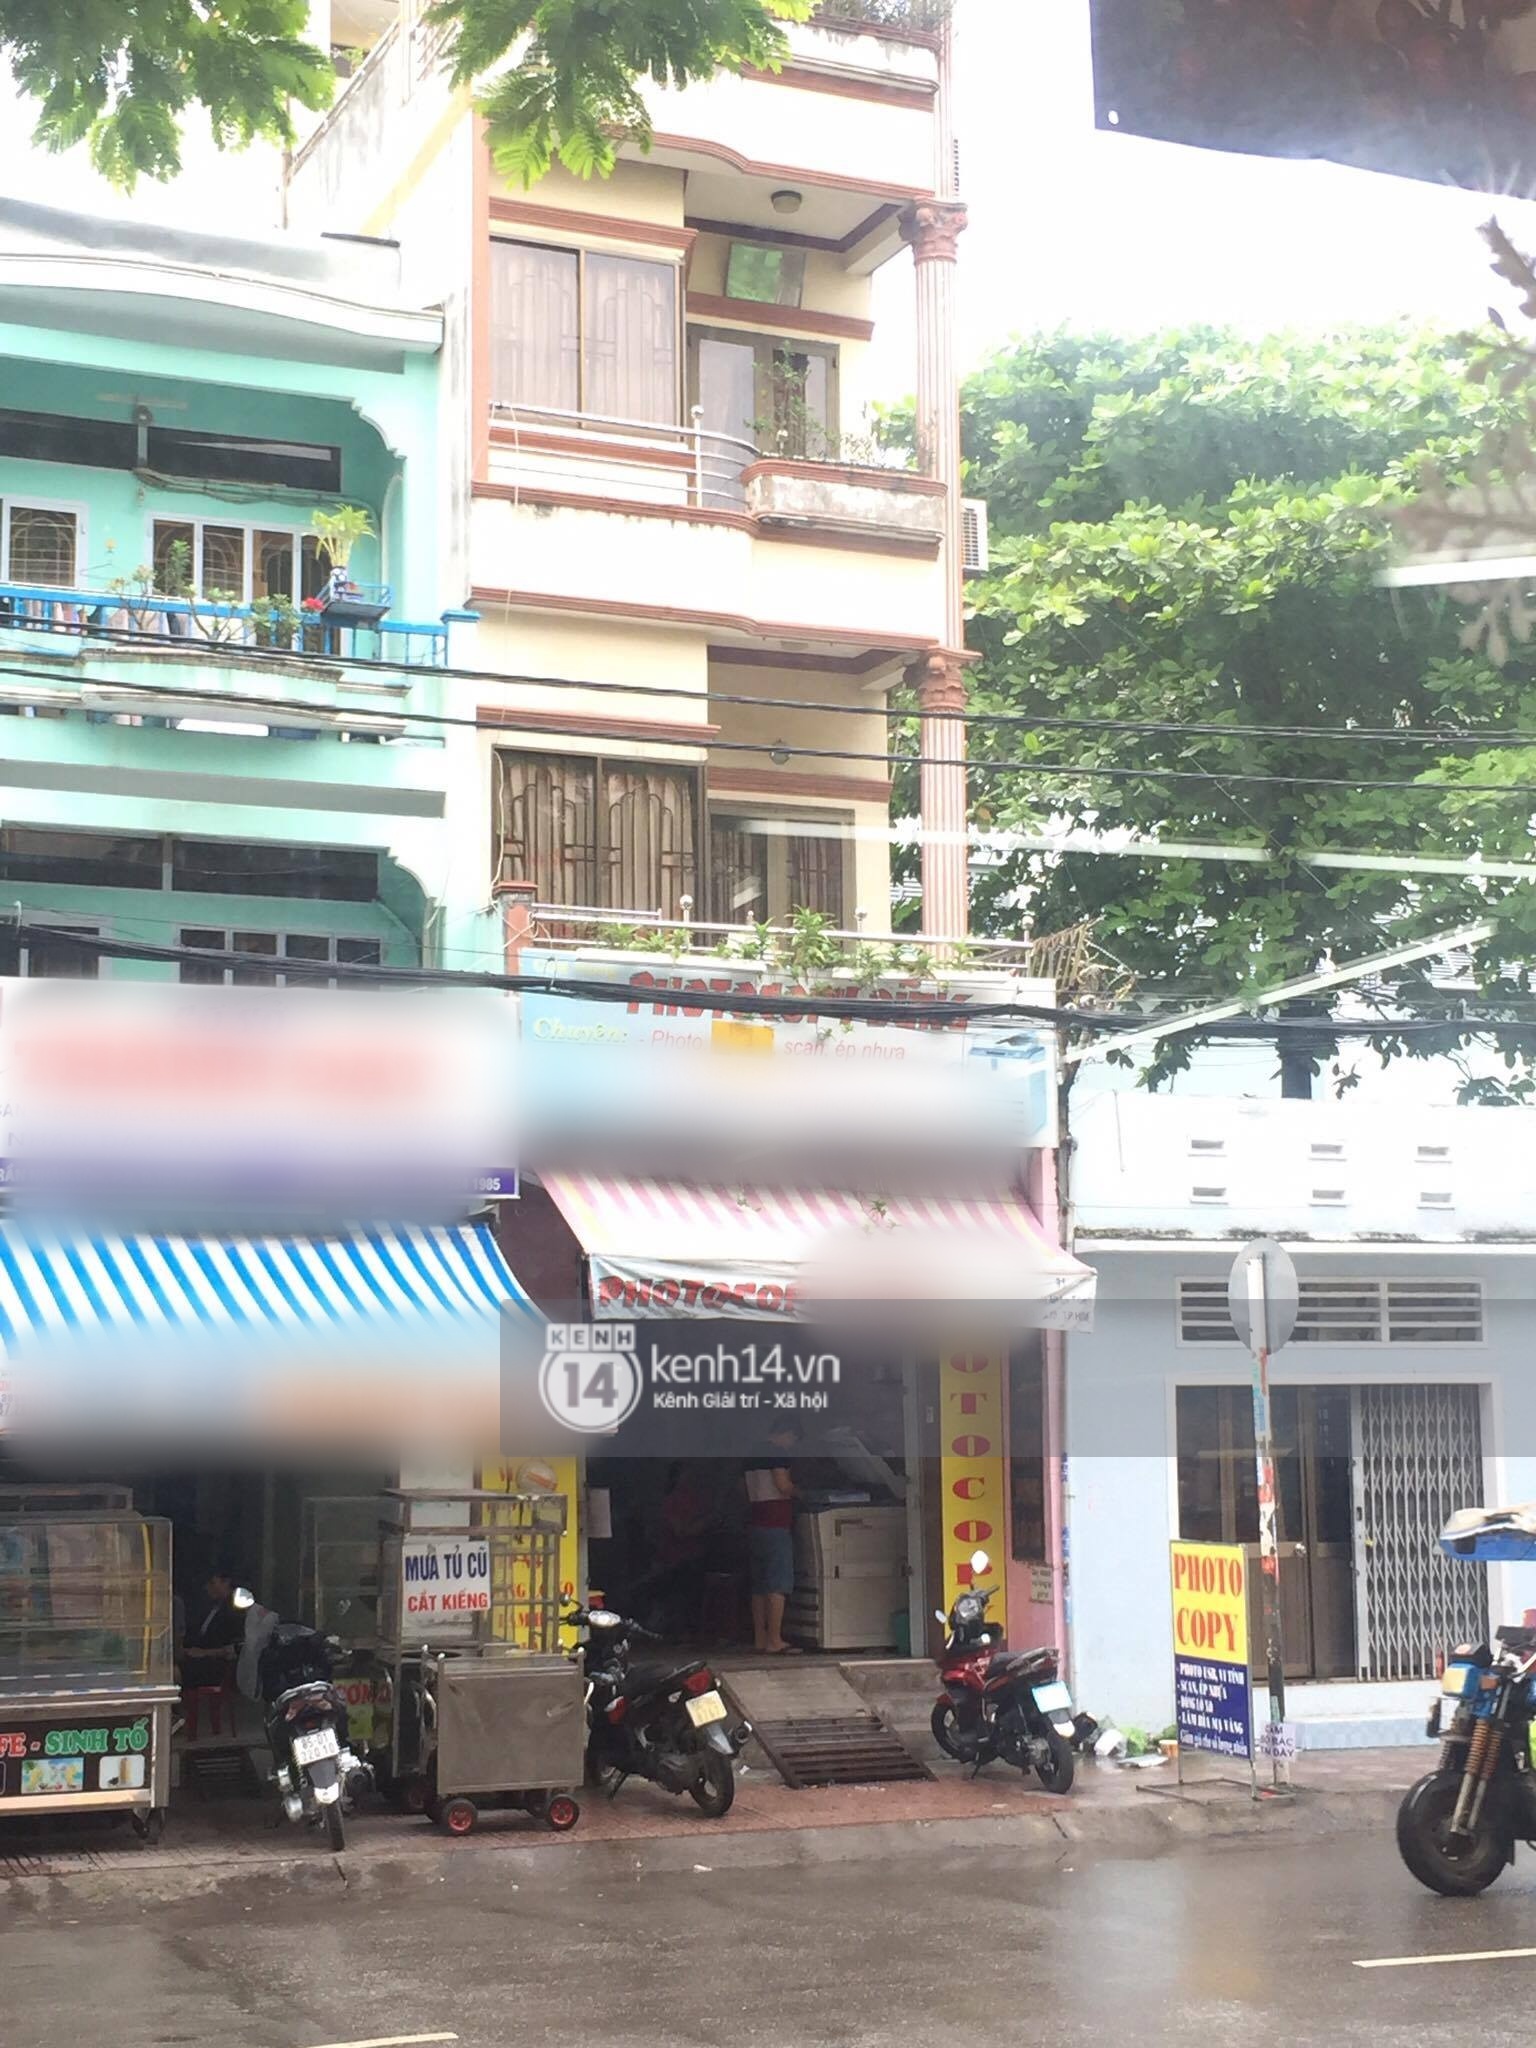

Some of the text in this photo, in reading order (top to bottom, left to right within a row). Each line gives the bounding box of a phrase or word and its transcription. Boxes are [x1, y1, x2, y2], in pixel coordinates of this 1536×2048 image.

[467, 1545, 487, 1577] CŨ
[1174, 1553, 1243, 1597] PHOTO
[1176, 1607, 1239, 1652] COPY
[45, 1729, 109, 1756] SINH
[113, 1717, 149, 1752] TỐ
